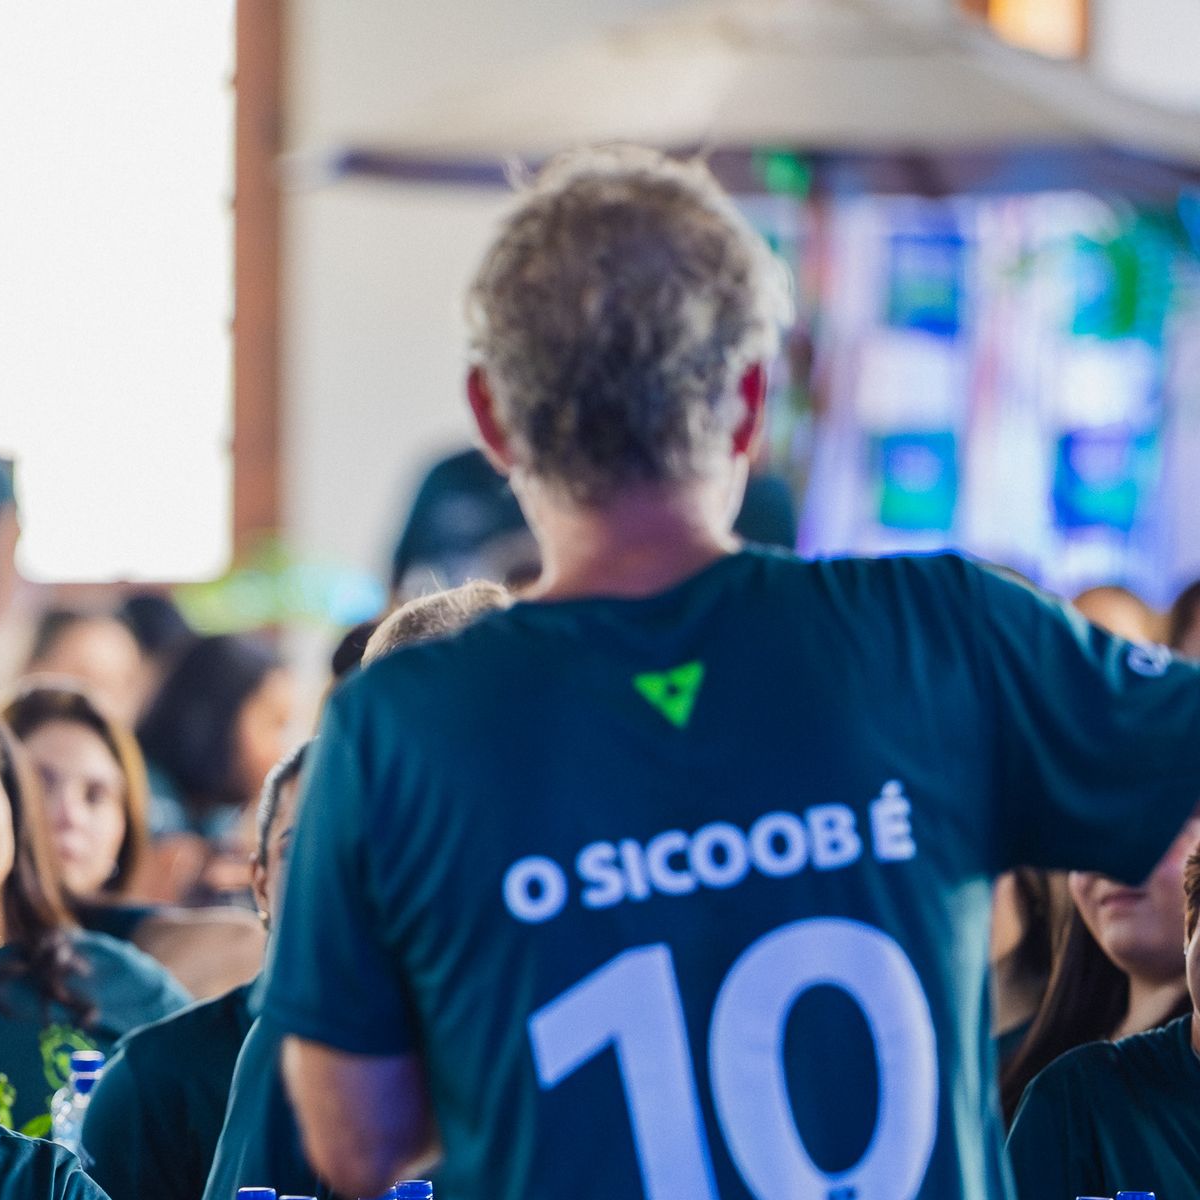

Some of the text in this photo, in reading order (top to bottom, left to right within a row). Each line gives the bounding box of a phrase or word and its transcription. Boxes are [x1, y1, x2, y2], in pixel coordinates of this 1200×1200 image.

[503, 780, 916, 923] O SICOOB É
